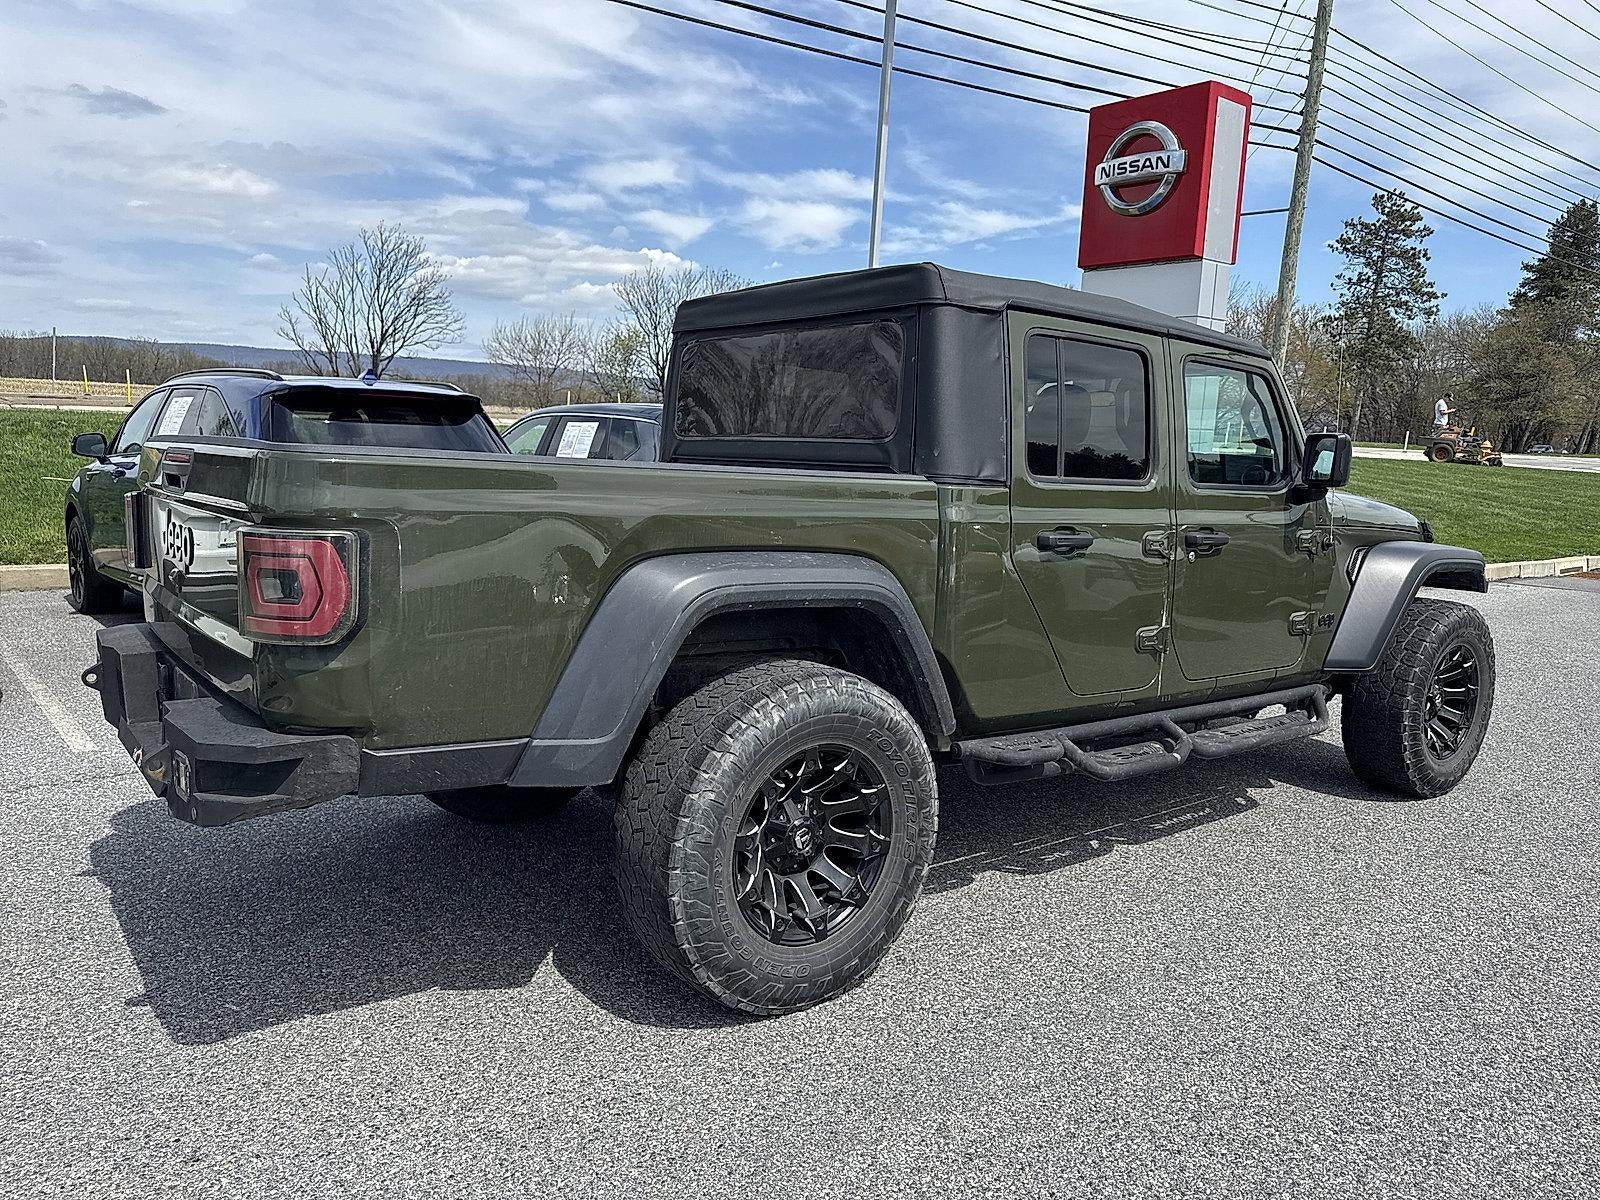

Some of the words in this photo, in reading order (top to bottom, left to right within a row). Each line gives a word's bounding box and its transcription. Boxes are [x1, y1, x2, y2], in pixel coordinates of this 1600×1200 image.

[1099, 154, 1171, 180] NISSAN
[162, 507, 195, 575] Jeep
[1317, 612, 1335, 629] eep
[866, 727, 910, 778] TOYO
[901, 779, 919, 863] TIRES
[752, 955, 812, 979] OPEN
